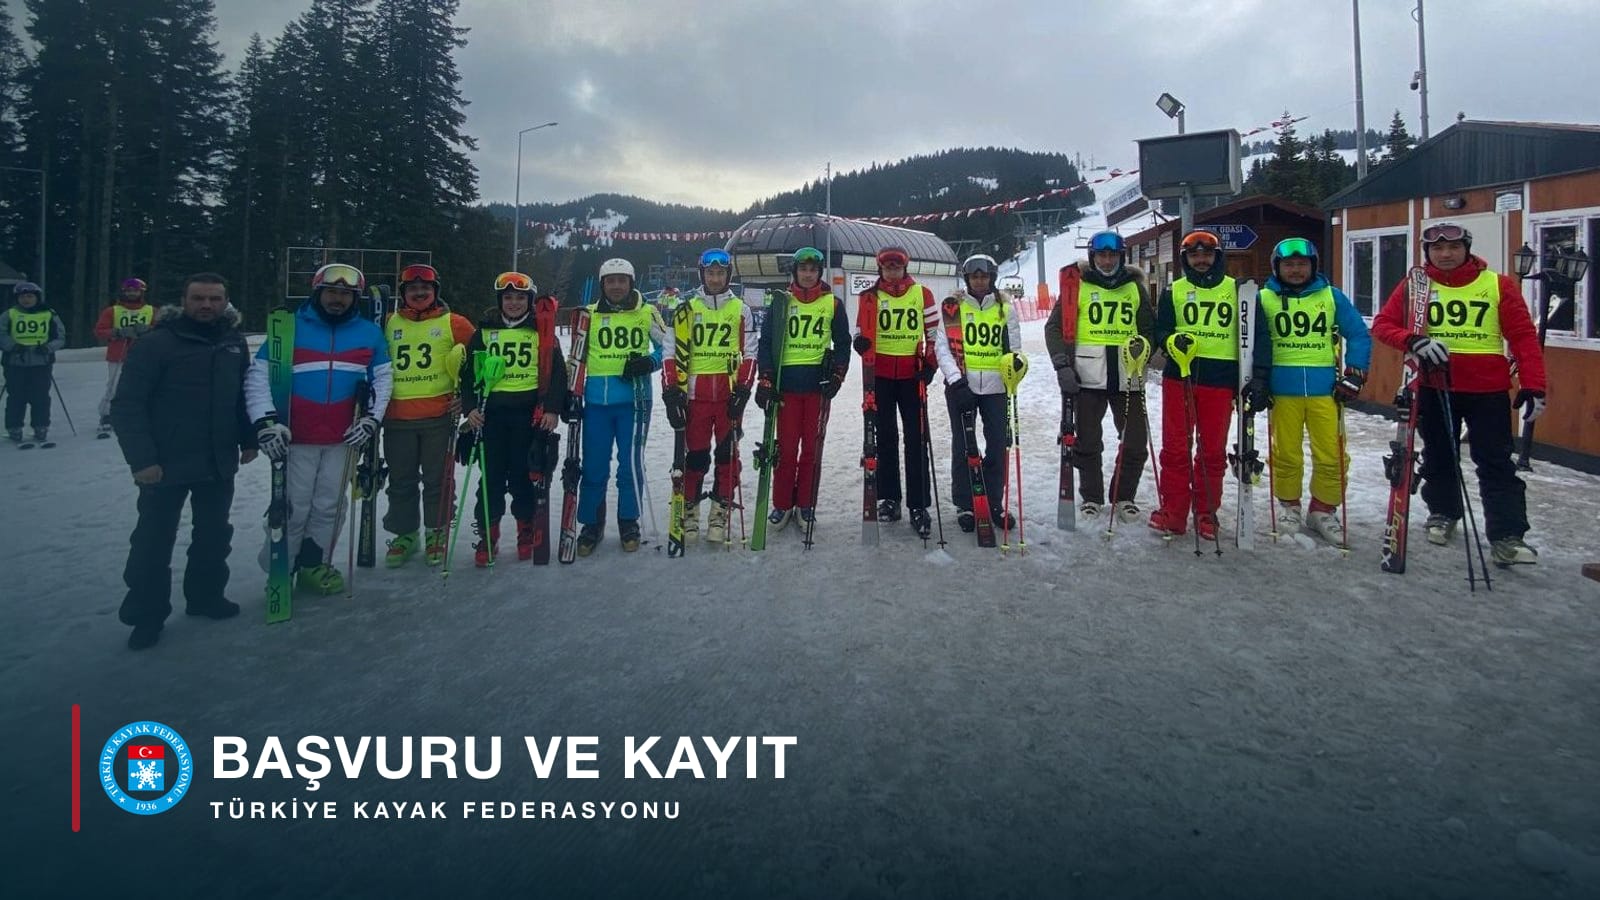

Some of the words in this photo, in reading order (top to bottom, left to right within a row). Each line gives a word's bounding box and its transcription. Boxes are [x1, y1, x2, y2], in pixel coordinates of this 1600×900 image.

[879, 308, 918, 331] 078
[1088, 301, 1134, 325] 075
[1183, 301, 1233, 327] 079
[1241, 300, 1249, 349] HEAD
[1274, 311, 1327, 337] 094
[1427, 300, 1490, 327] 097
[15, 320, 48, 334] 091
[598, 326, 644, 349] 080
[693, 323, 732, 347] 072
[788, 315, 824, 339] 074
[965, 322, 1001, 347] 098
[396, 343, 432, 371] 53
[270, 584, 281, 614] SLX
